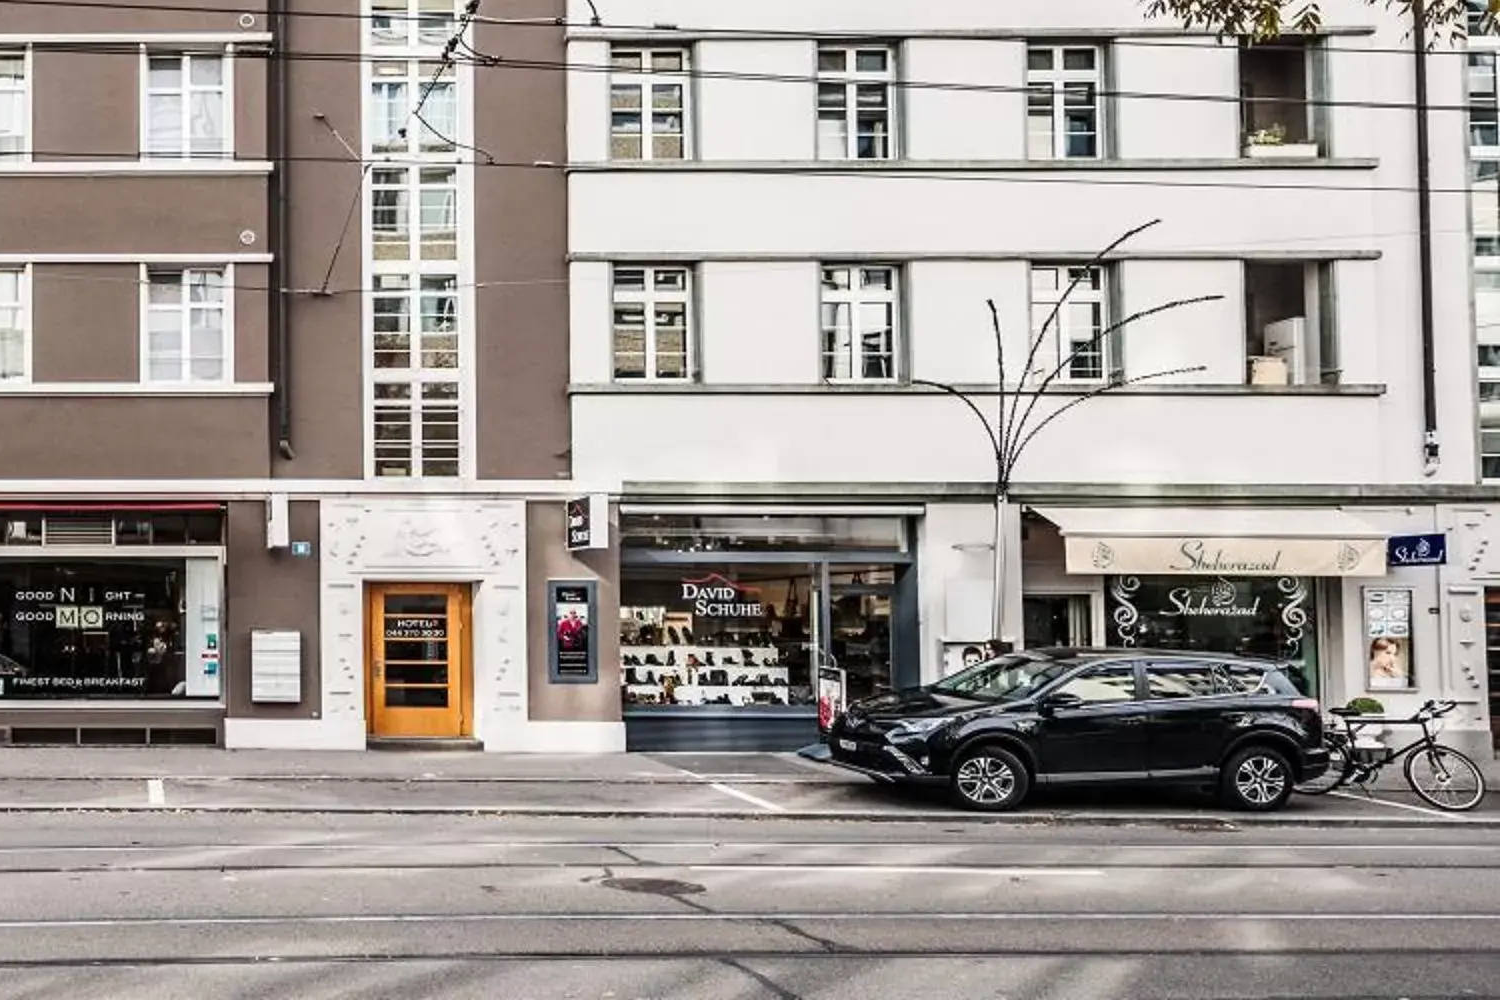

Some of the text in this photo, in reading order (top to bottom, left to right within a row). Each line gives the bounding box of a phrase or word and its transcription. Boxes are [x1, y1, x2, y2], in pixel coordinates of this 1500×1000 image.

[15, 591, 54, 601] GOOD
[681, 583, 735, 599] DAVID
[1159, 587, 1260, 616] Sheherazad
[695, 600, 763, 617] SCHUHE
[15, 611, 54, 621] GOOD
[13, 677, 50, 687] FINEST
[84, 677, 146, 687] BREAKFAST
